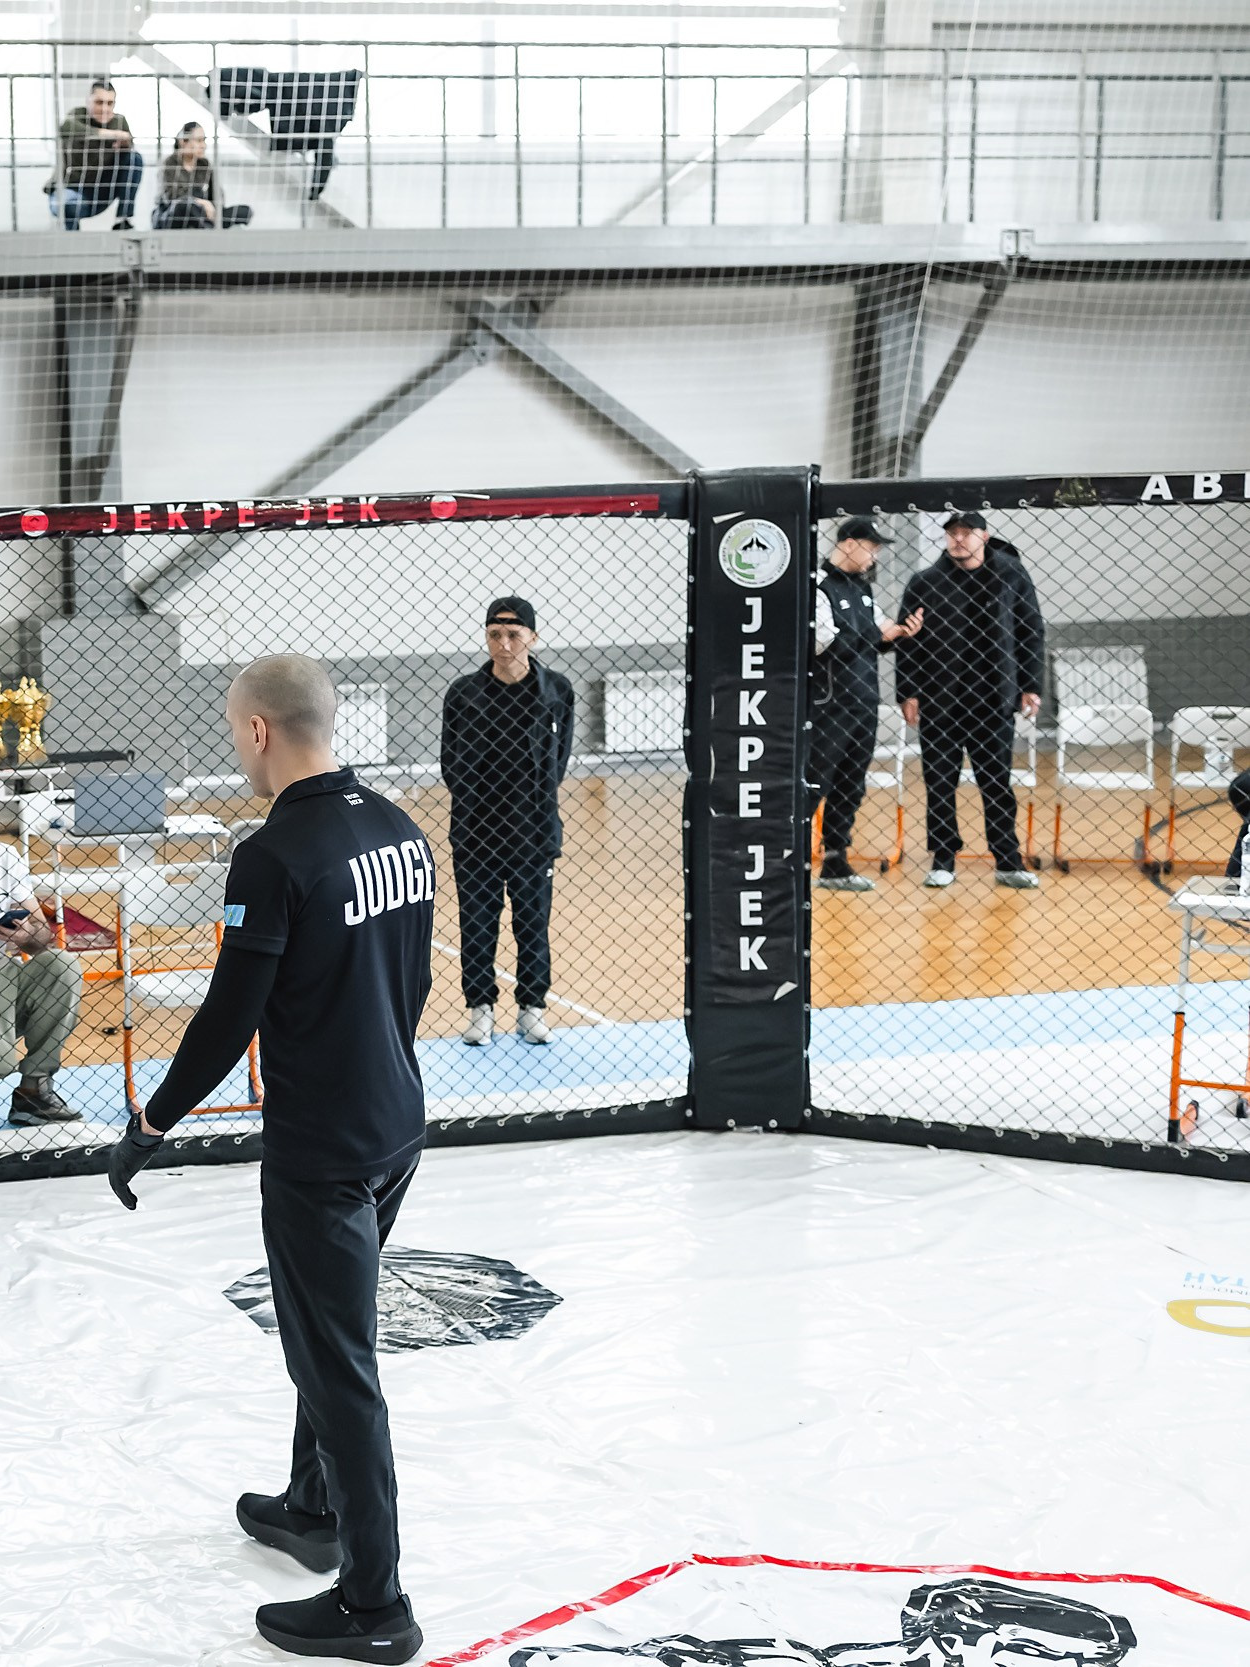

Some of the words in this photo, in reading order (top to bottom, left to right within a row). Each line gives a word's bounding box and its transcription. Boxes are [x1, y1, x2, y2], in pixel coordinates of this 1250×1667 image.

[102, 500, 266, 534] JEKPE
[295, 496, 381, 525] JEK
[738, 597, 768, 818] JEKPE
[739, 844, 769, 971] JEK
